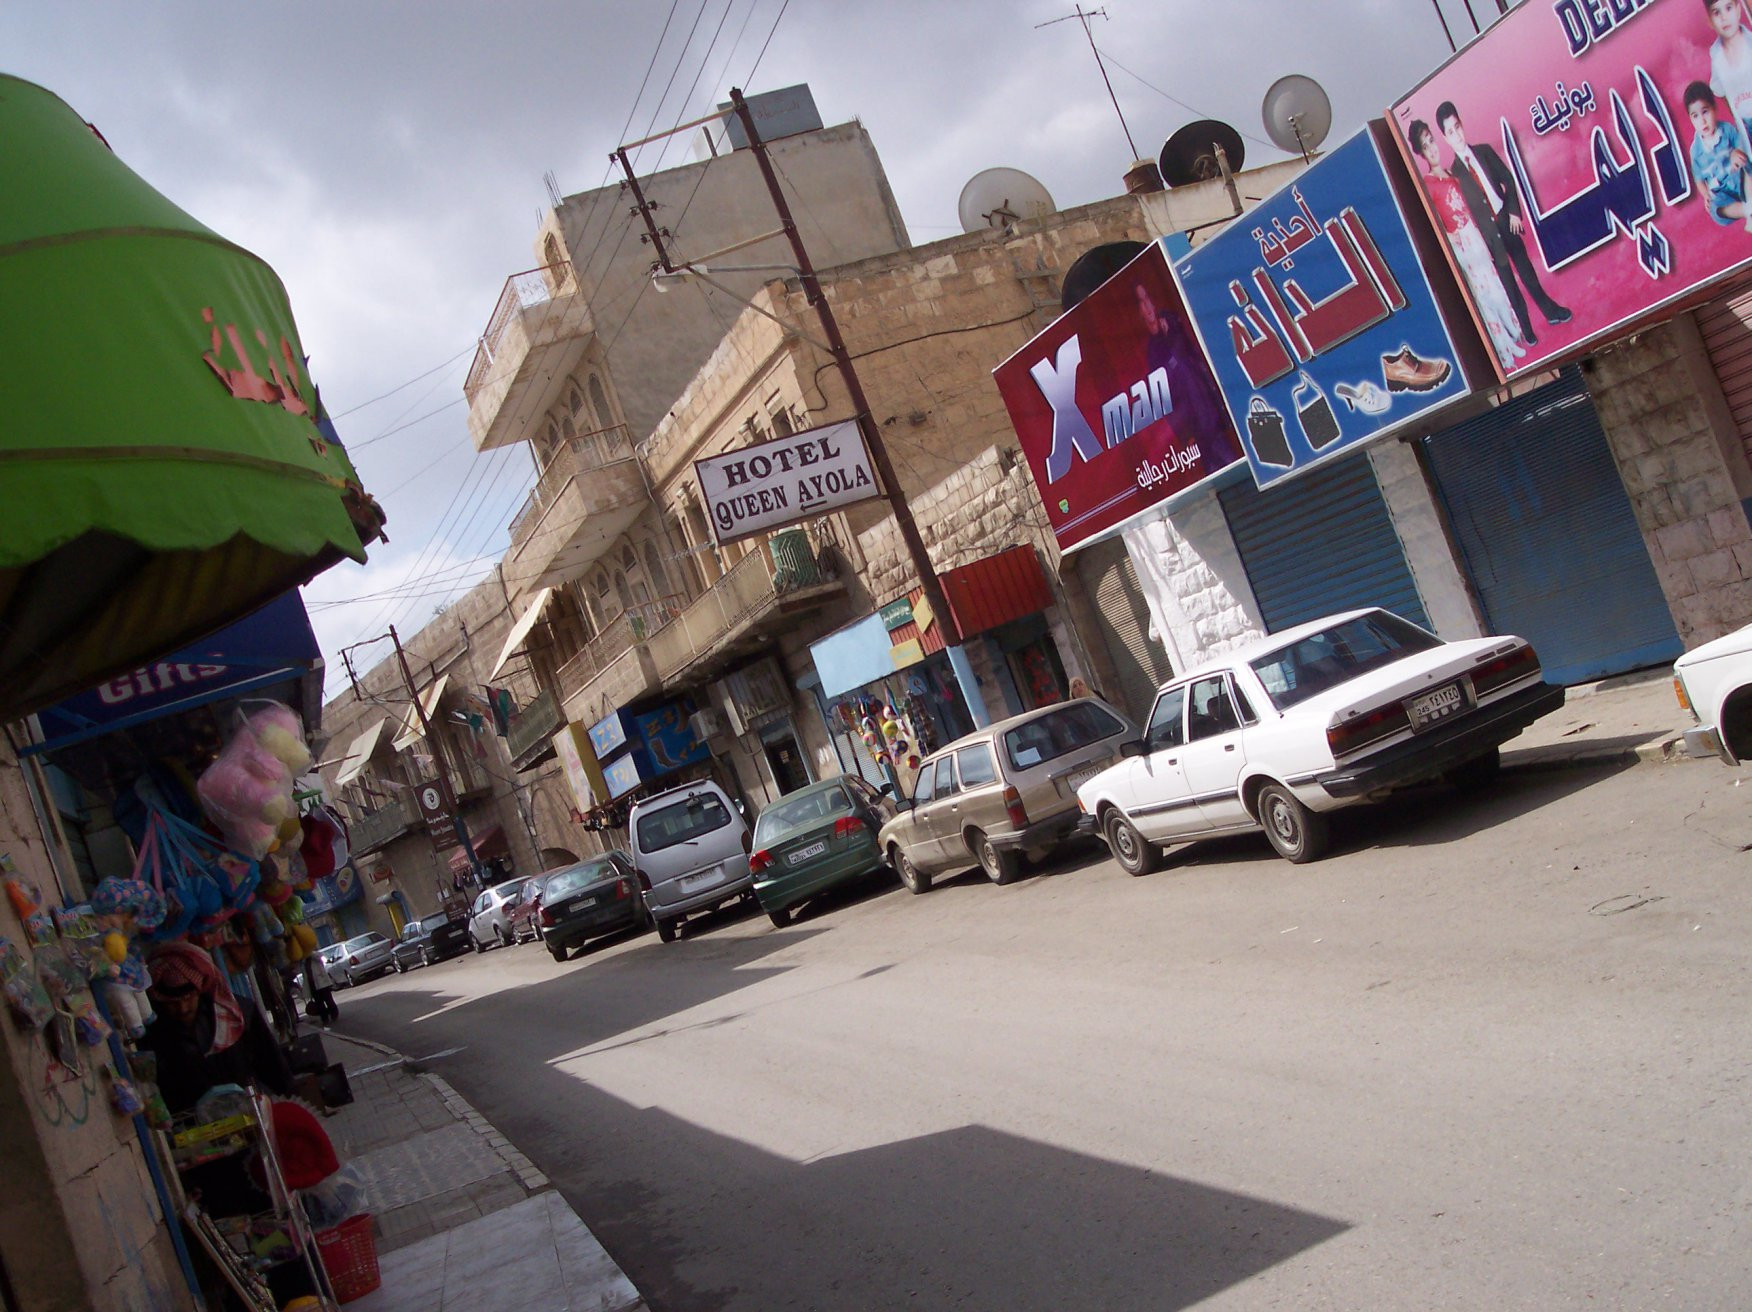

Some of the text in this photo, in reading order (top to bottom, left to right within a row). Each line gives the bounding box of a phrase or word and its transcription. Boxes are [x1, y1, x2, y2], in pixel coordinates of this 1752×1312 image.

[1530, 81, 1597, 136] بوتيك
[1251, 185, 1323, 271] أحذية
[1029, 333, 1174, 485] X man
[722, 437, 841, 488] HOTEL
[715, 464, 871, 531] QUEEN AYOLA
[99, 662, 227, 703] Gifts
